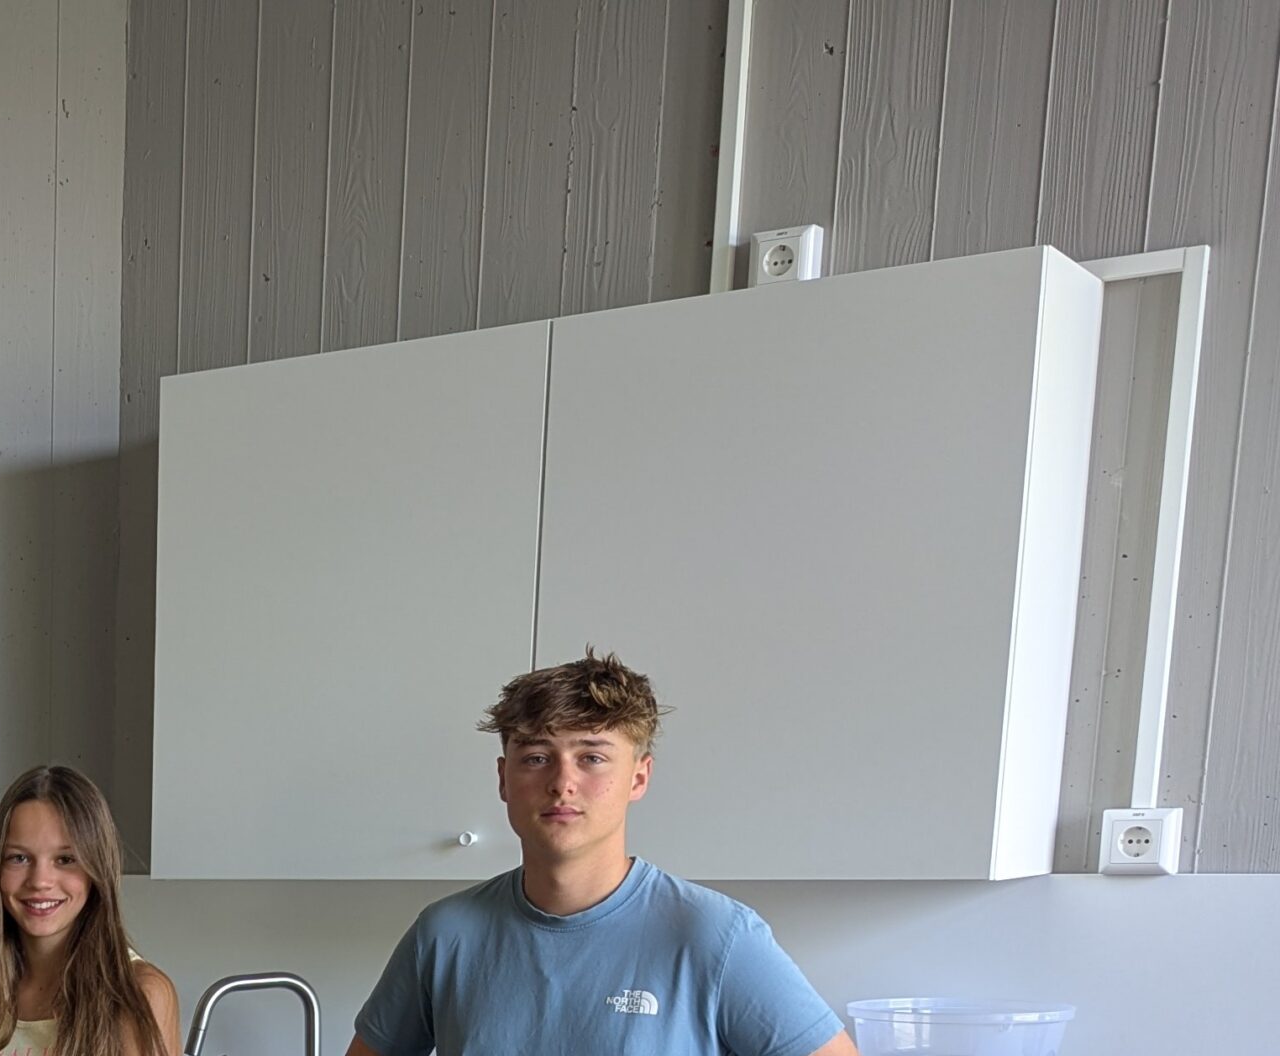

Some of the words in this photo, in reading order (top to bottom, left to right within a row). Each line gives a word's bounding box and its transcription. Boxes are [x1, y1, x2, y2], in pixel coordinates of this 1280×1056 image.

[622, 989, 642, 999] THE
[606, 996, 641, 1006] NORTH
[614, 1004, 640, 1014] FACE
